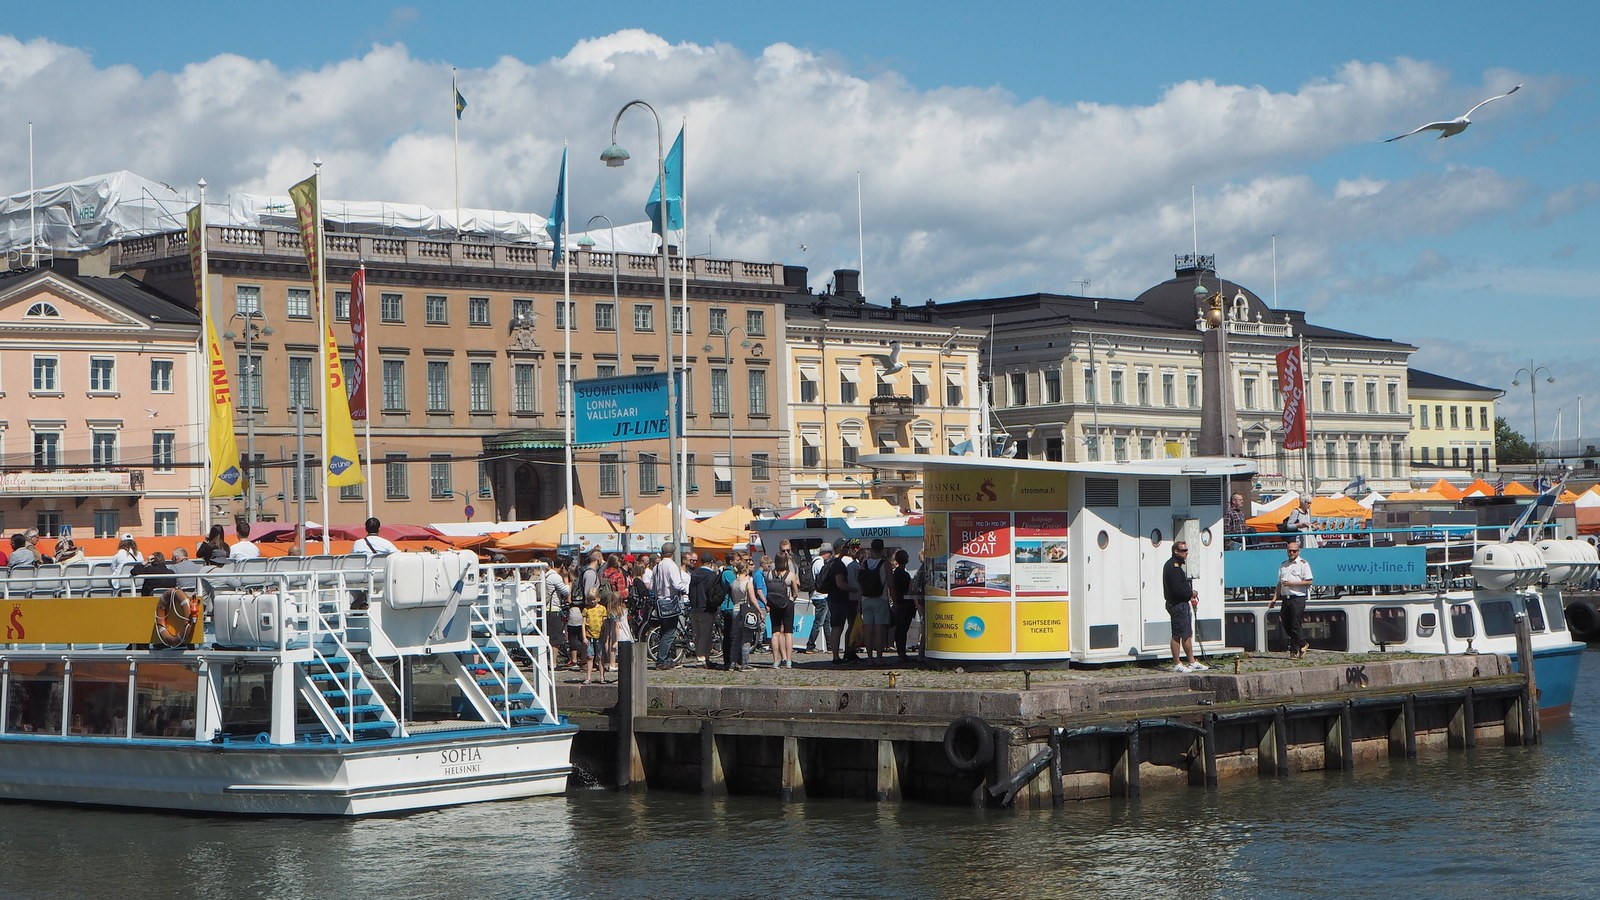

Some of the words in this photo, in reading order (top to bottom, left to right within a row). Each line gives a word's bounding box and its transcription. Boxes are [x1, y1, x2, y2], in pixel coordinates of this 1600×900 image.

[579, 381, 660, 398] SUOMENLINNA
[586, 399, 618, 410] LONNA
[586, 407, 638, 420] VALLISAARI
[612, 419, 668, 437] JT-LINE
[860, 527, 891, 537] VIAPORI
[962, 531, 984, 542] BUS
[987, 531, 997, 542] &
[962, 542, 997, 555] BOAT
[1337, 561, 1415, 574] www.jt-line.fi
[935, 613, 954, 621] ONLINE
[932, 622, 959, 630] BOOKINGS
[441, 747, 482, 764] SOFIA
[444, 764, 480, 775] HELSINKI
